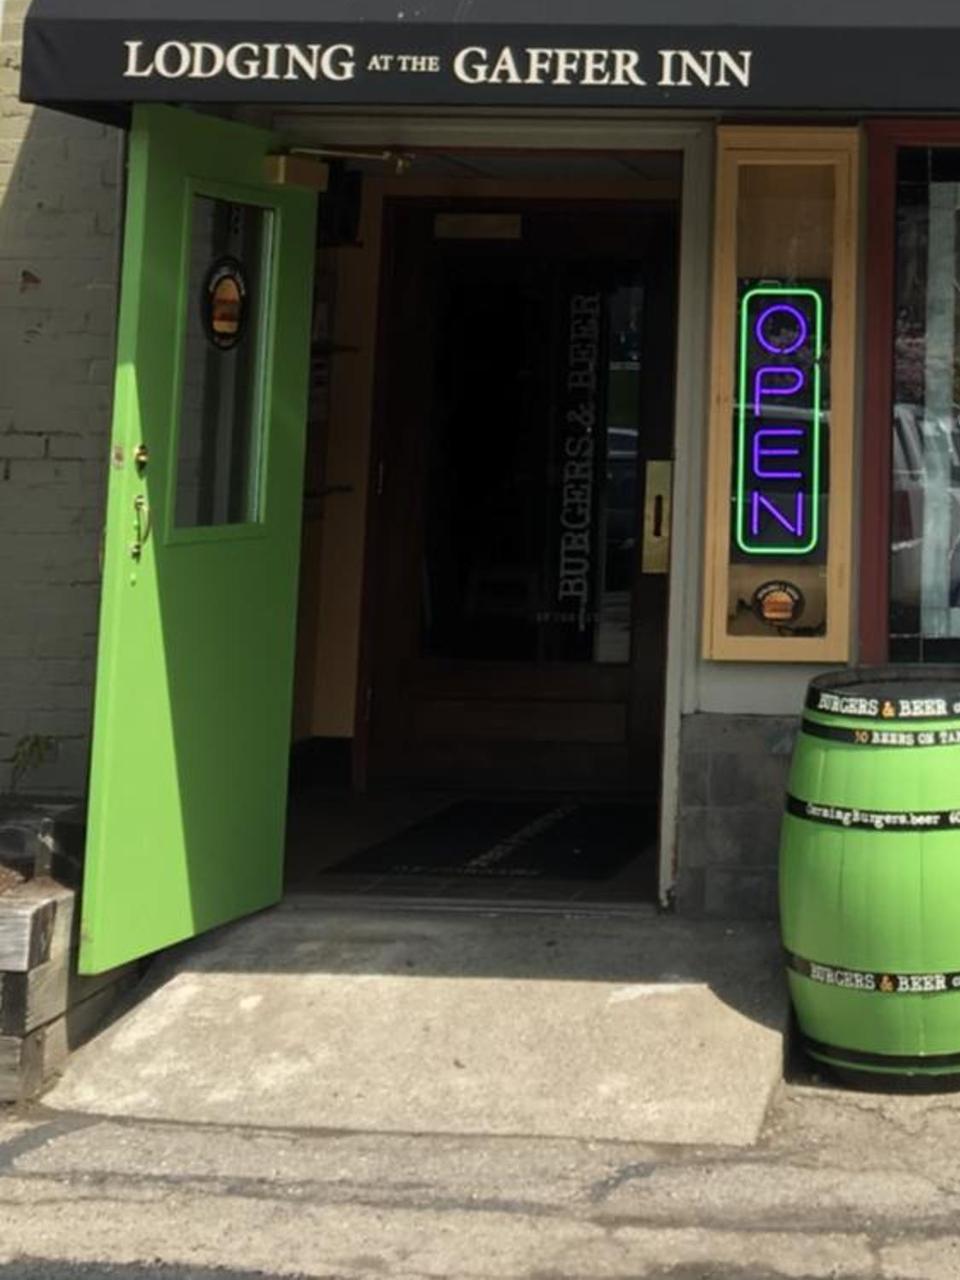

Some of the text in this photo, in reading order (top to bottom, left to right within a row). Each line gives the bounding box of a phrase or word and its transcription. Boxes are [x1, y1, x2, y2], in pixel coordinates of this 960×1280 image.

[123, 40, 752, 87] LODGING AT THE GAFFER INN
[568, 293, 601, 392] BEER
[754, 303, 808, 537] OPEN
[559, 436, 592, 632] BURGERS
[818, 693, 880, 717] BURGERS
[882, 700, 896, 718] &
[899, 698, 948, 717] BEER
[871, 731, 915, 745] BEERS
[810, 963, 876, 991] BURGERS
[878, 974, 894, 992] &
[896, 974, 947, 992] BEER
